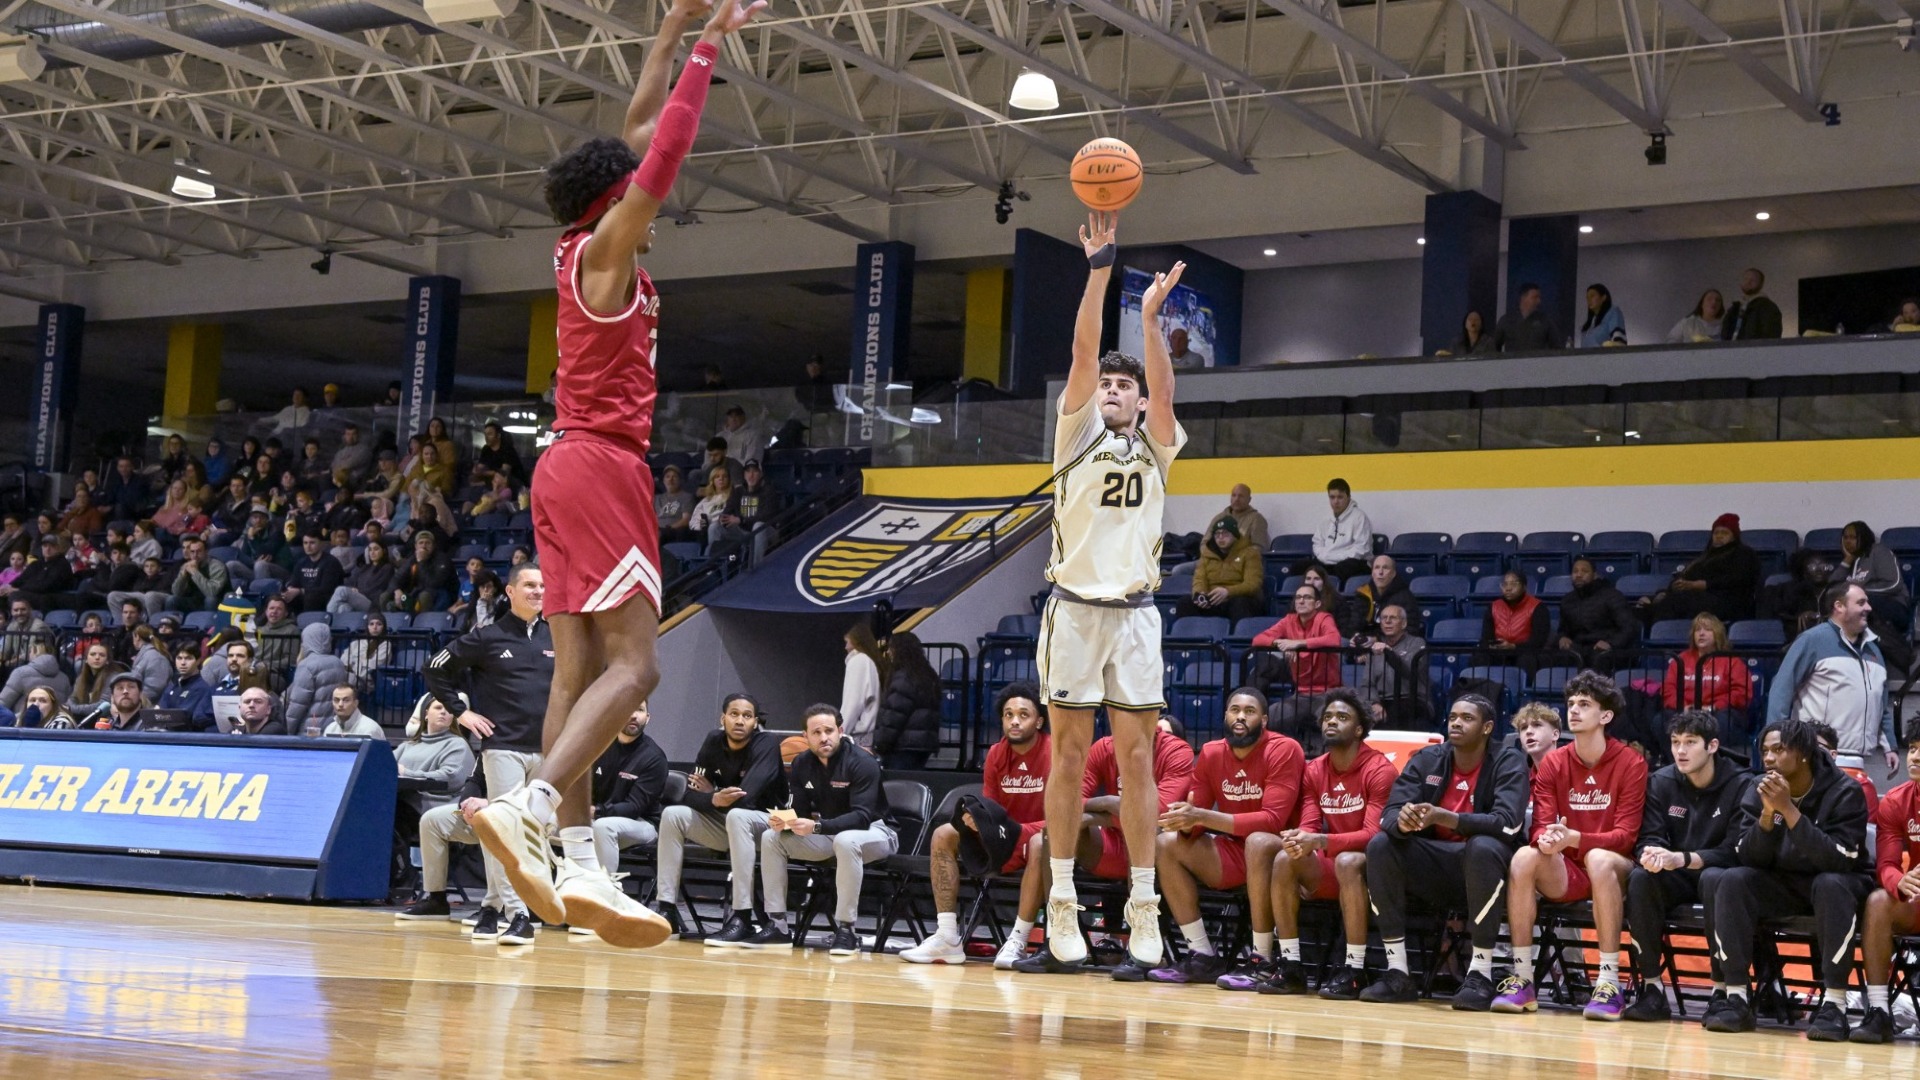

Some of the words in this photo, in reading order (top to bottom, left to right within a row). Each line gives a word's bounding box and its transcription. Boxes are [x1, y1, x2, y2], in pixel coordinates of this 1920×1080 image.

[869, 252, 884, 307] CLUB
[417, 286, 431, 335] CLUB
[35, 361, 54, 466] CHAMPIONS
[45, 312, 58, 357] CLUB
[409, 340, 426, 442] HAMPIONS
[860, 312, 880, 441] CHAMPIONS
[1100, 471, 1144, 508] 20
[81, 767, 269, 822] ARENA
[1221, 779, 1245, 795] Sacred
